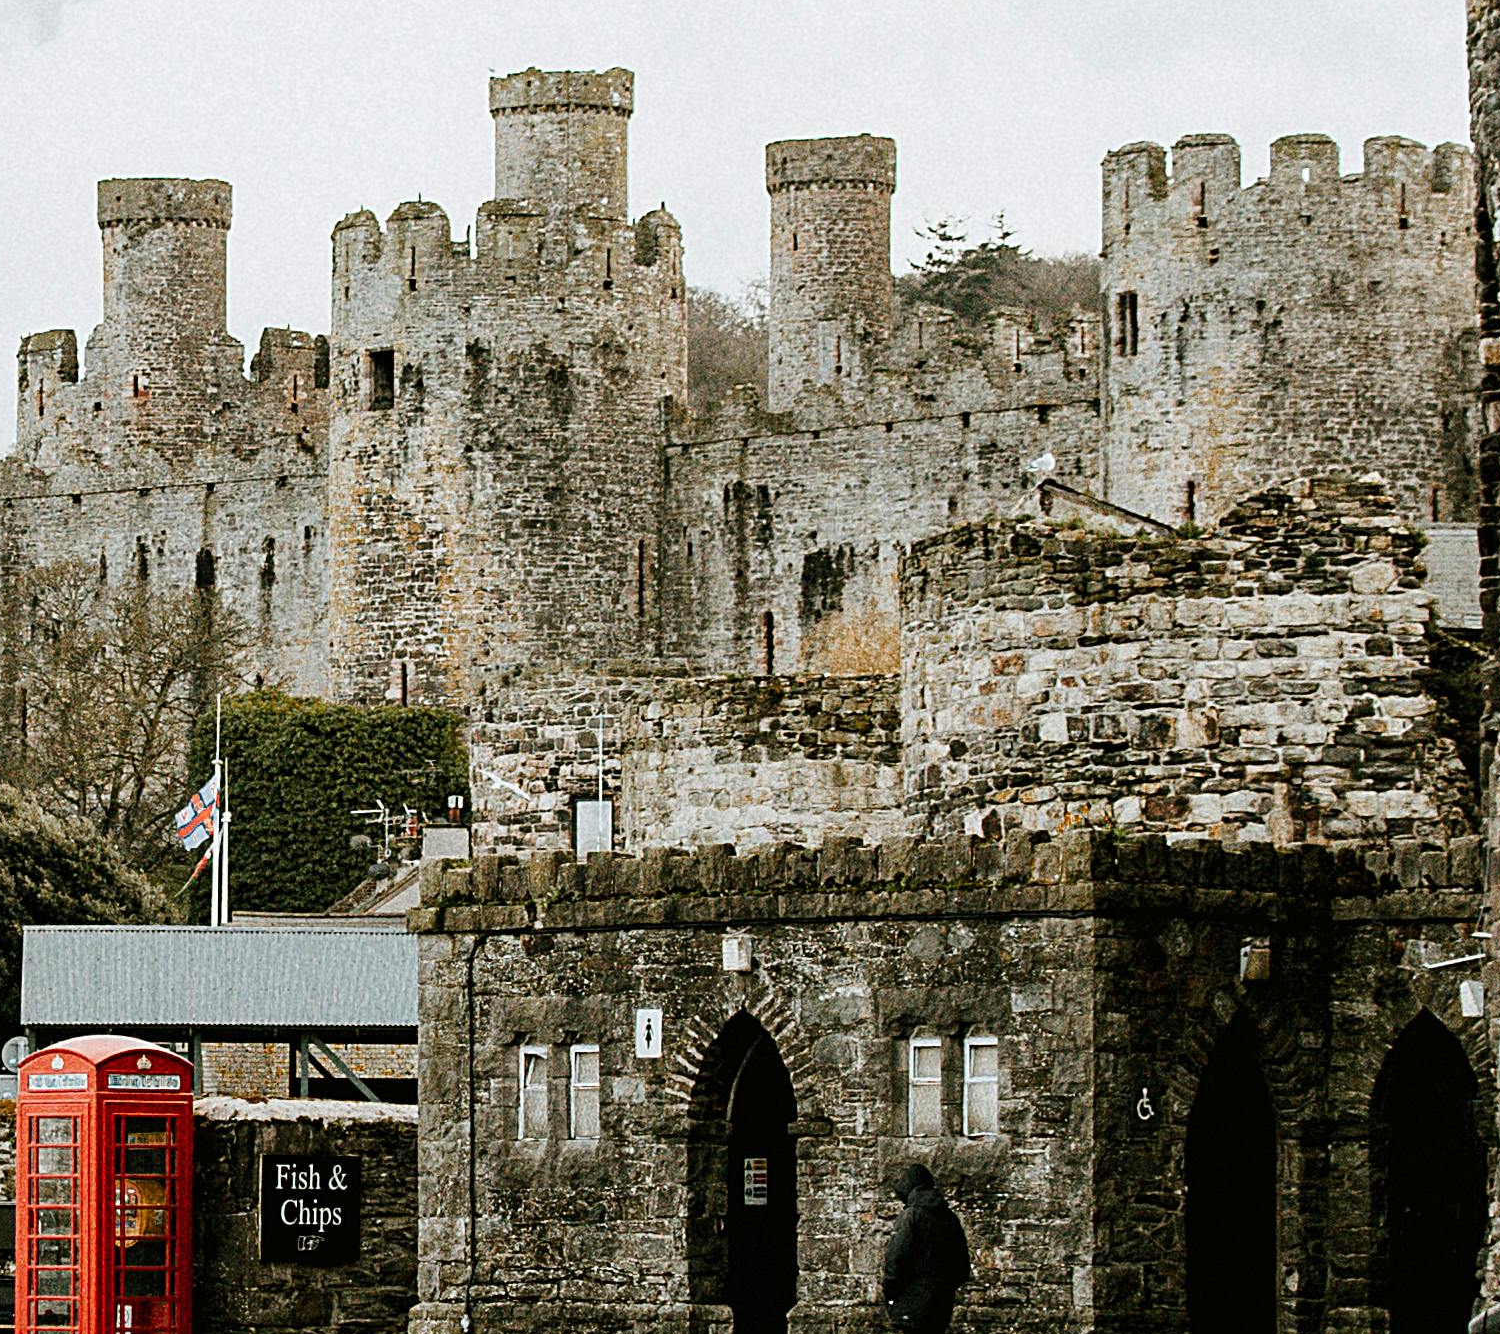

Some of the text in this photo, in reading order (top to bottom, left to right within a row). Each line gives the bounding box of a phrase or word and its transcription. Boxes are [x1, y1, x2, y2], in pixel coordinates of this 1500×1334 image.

[274, 1163, 349, 1191] Fish &
[280, 1198, 342, 1233] Chips
